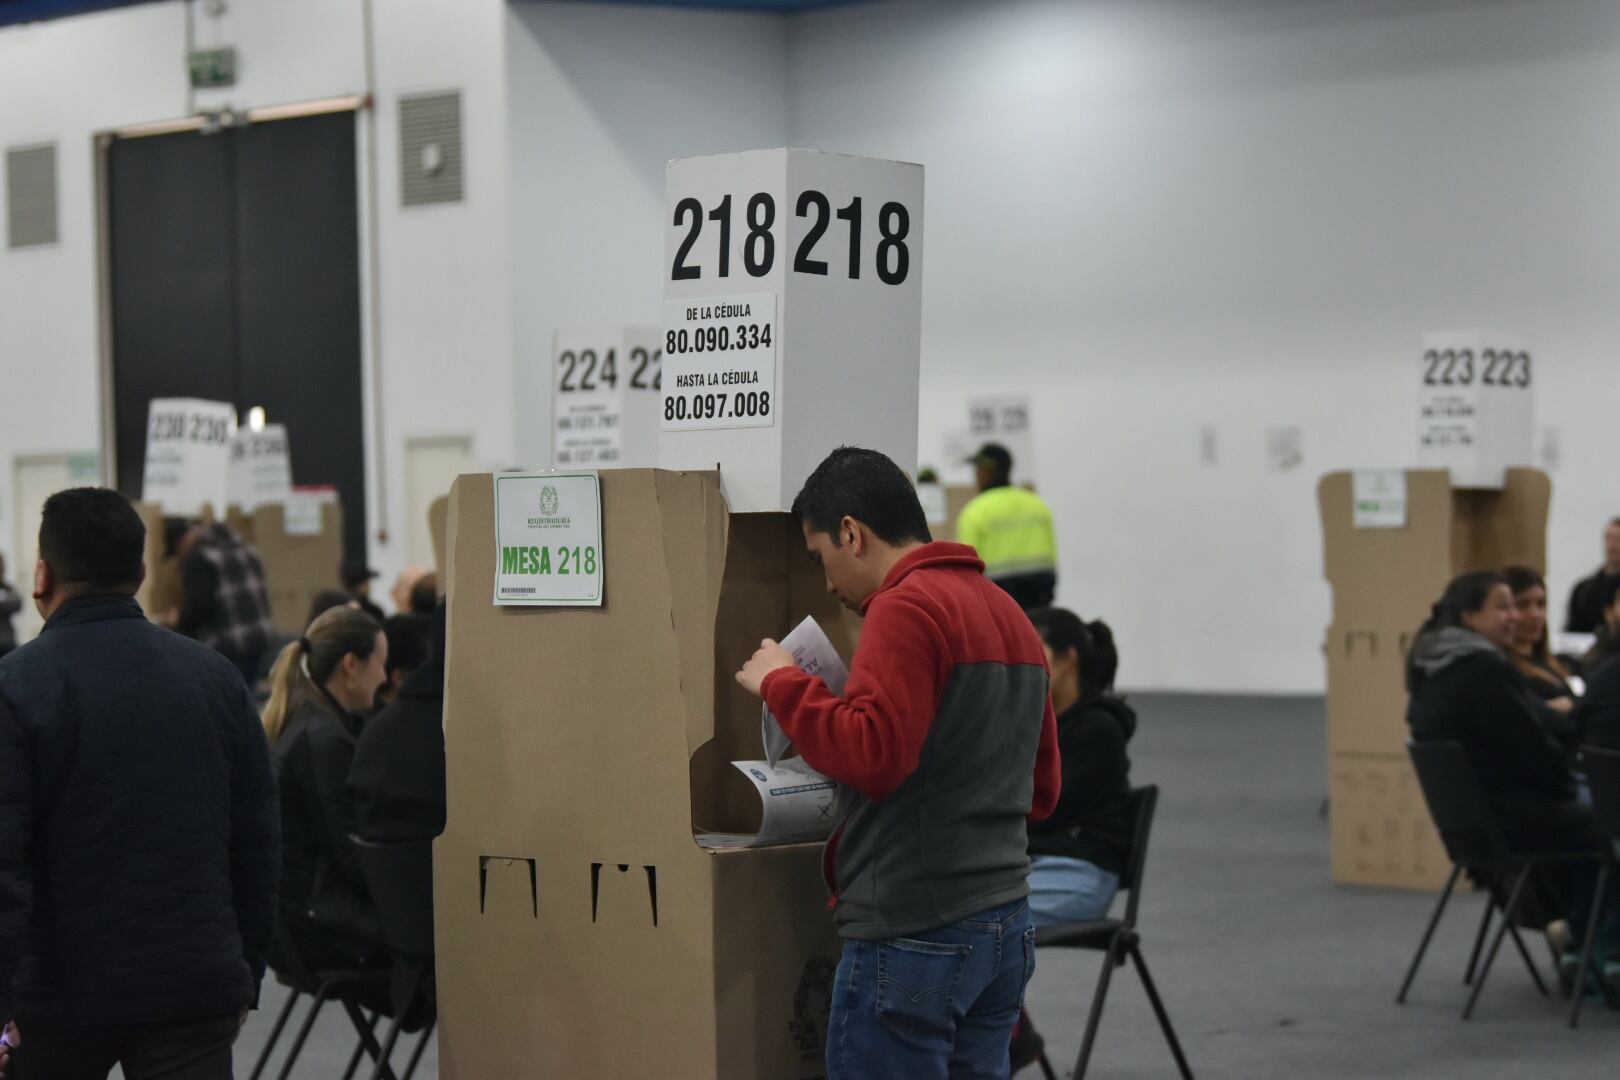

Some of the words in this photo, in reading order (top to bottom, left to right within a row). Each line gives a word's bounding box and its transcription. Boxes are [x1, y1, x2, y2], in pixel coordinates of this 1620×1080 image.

[671, 192, 776, 281] 218
[793, 190, 910, 285] 218
[686, 307, 698, 320] DE
[700, 306, 712, 320] LA
[714, 302, 751, 319] CÉDULA
[666, 323, 772, 354] 80.090.334
[559, 348, 617, 392] 224
[630, 347, 662, 391] 22
[676, 374, 705, 388] HASTA
[707, 373, 719, 386] LA
[721, 369, 759, 385] CÉDULA
[1423, 348, 1475, 386] 223
[1481, 347, 1532, 389] 223
[664, 390, 770, 421] 80.097.008
[502, 546, 551, 575] MESA
[557, 546, 596, 575] 218
